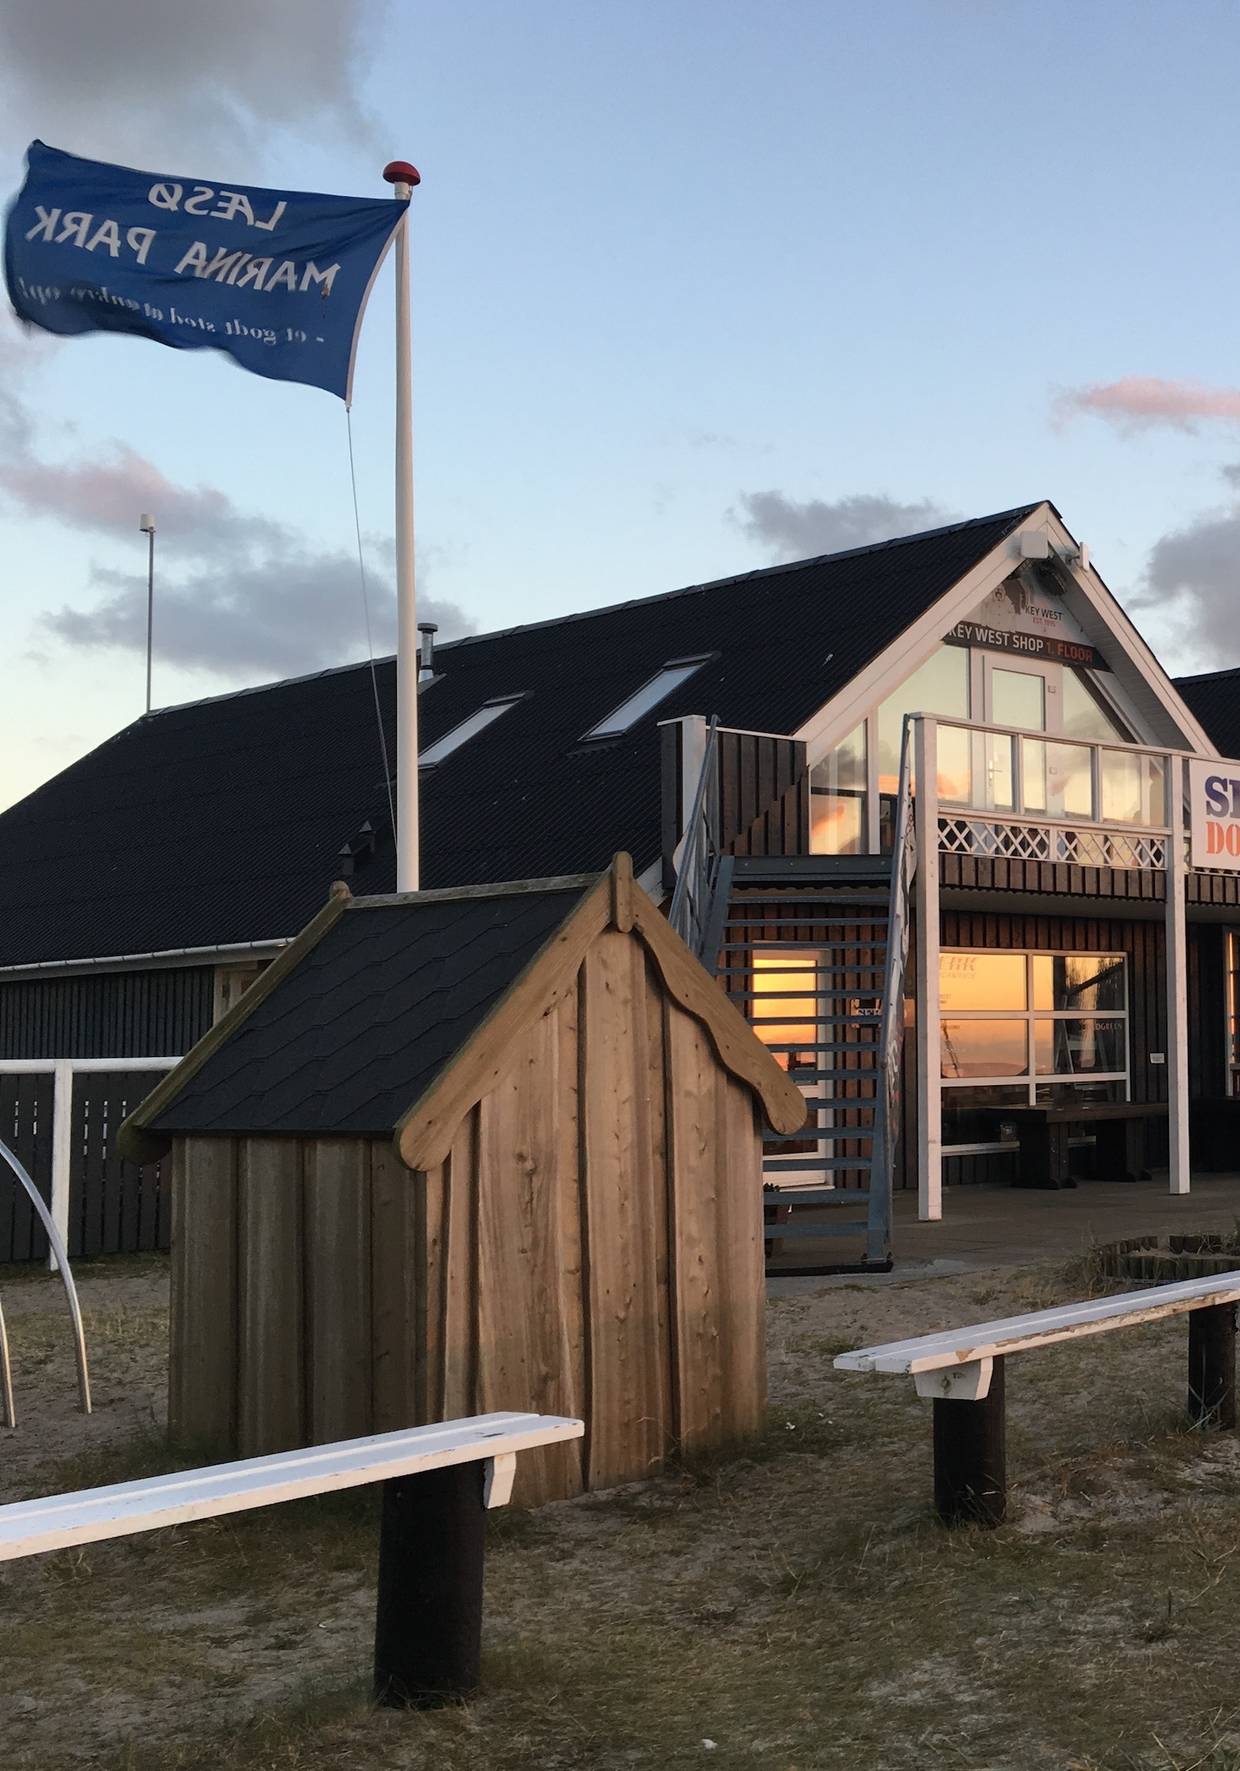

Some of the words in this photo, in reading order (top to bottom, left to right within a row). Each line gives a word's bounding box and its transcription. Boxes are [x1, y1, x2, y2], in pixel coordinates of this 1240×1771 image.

[1025, 605, 1040, 616] KEY
[1041, 608, 1062, 621] WEST
[975, 627, 1010, 647] WEST
[1013, 634, 1044, 652] SHOP
[1056, 643, 1093, 663] FLOOR
